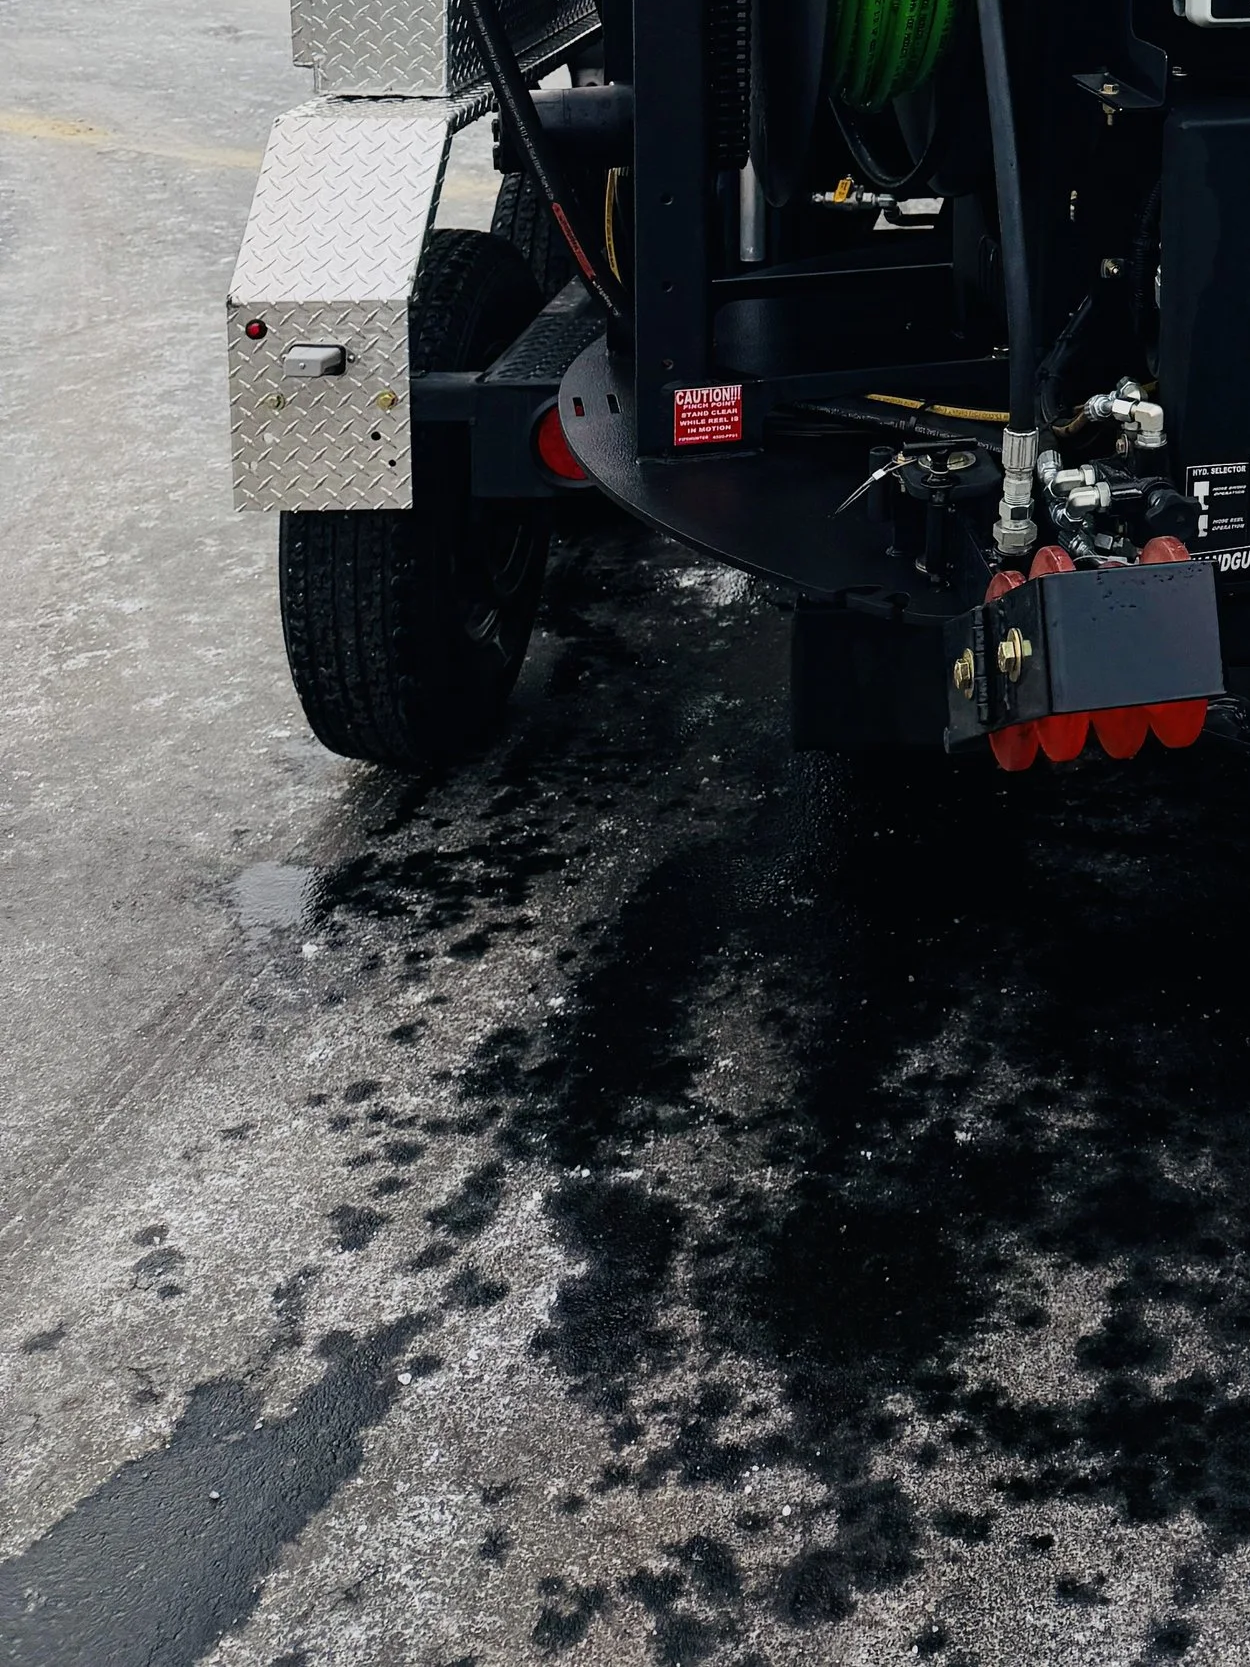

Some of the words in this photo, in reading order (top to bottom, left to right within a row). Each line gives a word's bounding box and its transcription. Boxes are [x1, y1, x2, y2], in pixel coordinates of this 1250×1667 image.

[676, 387, 740, 405] CAUTION!!!
[683, 402, 708, 410] PINCH
[699, 425, 731, 433] MOTION
[1211, 466, 1246, 474] SELECTOR
